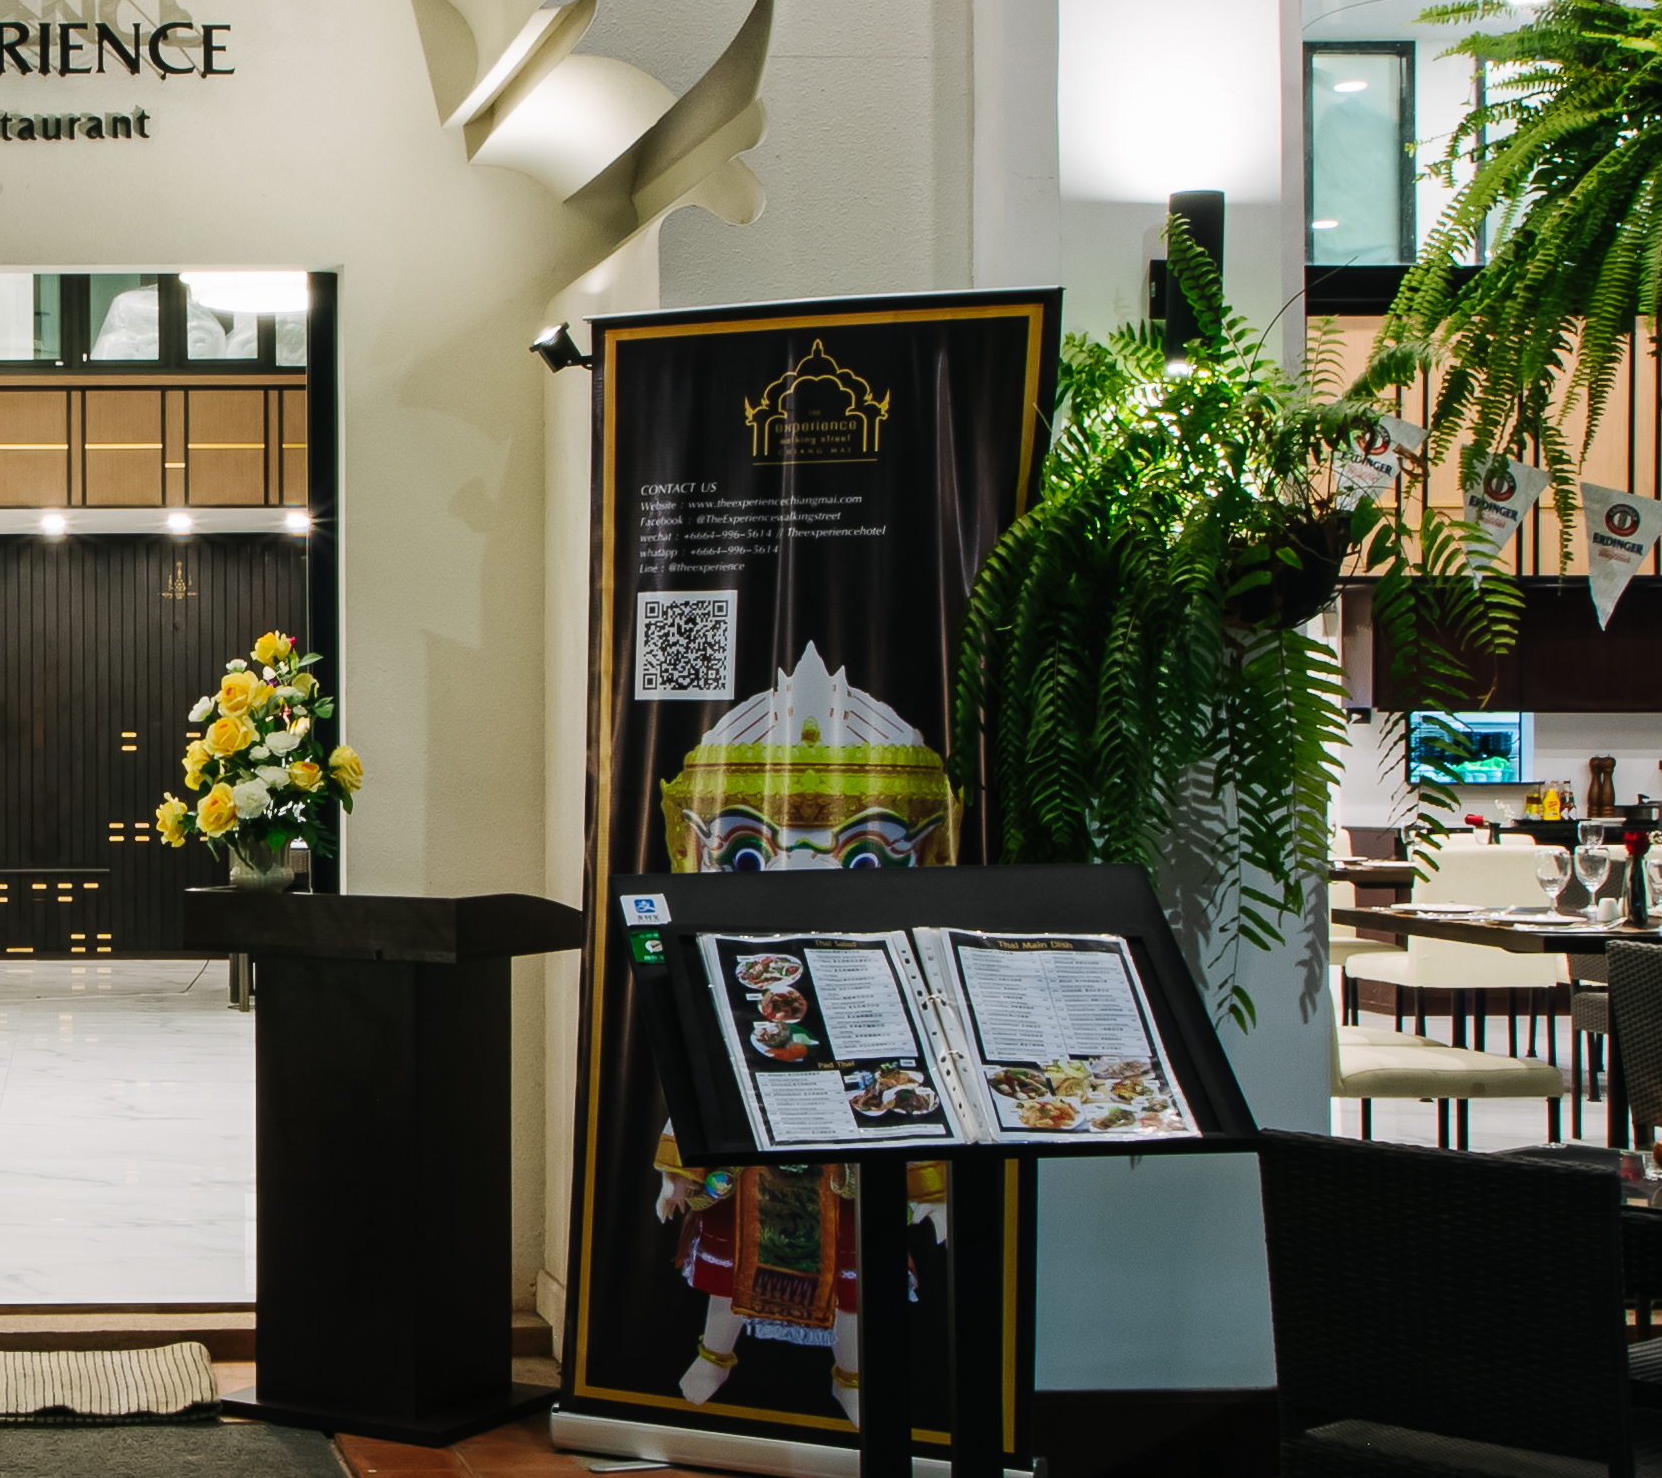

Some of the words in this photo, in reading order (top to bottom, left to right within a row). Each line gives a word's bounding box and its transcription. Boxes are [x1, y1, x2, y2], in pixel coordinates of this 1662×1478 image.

[775, 420, 857, 434] experience
[820, 433, 851, 443] street
[830, 446, 852, 454] MAI
[1341, 451, 1393, 475] EDINGER
[640, 482, 697, 496] CONTACT
[700, 481, 718, 494] US
[640, 500, 677, 511] Website
[687, 494, 863, 510] www.theexperiencechiangmai.com
[639, 515, 684, 527] Facebook
[696, 511, 842, 525] @TheExperiencewalkingstreet
[639, 532, 672, 542] wechat
[787, 525, 887, 540] Theexperiencehotel
[1592, 532, 1644, 556] ERDINGER
[639, 548, 678, 559] whatapp
[639, 564, 658, 574] Line
[668, 562, 746, 574] @theexperience
[997, 940, 1020, 949] Thai
[1021, 940, 1048, 949] Main
[1049, 940, 1074, 950] Dish
